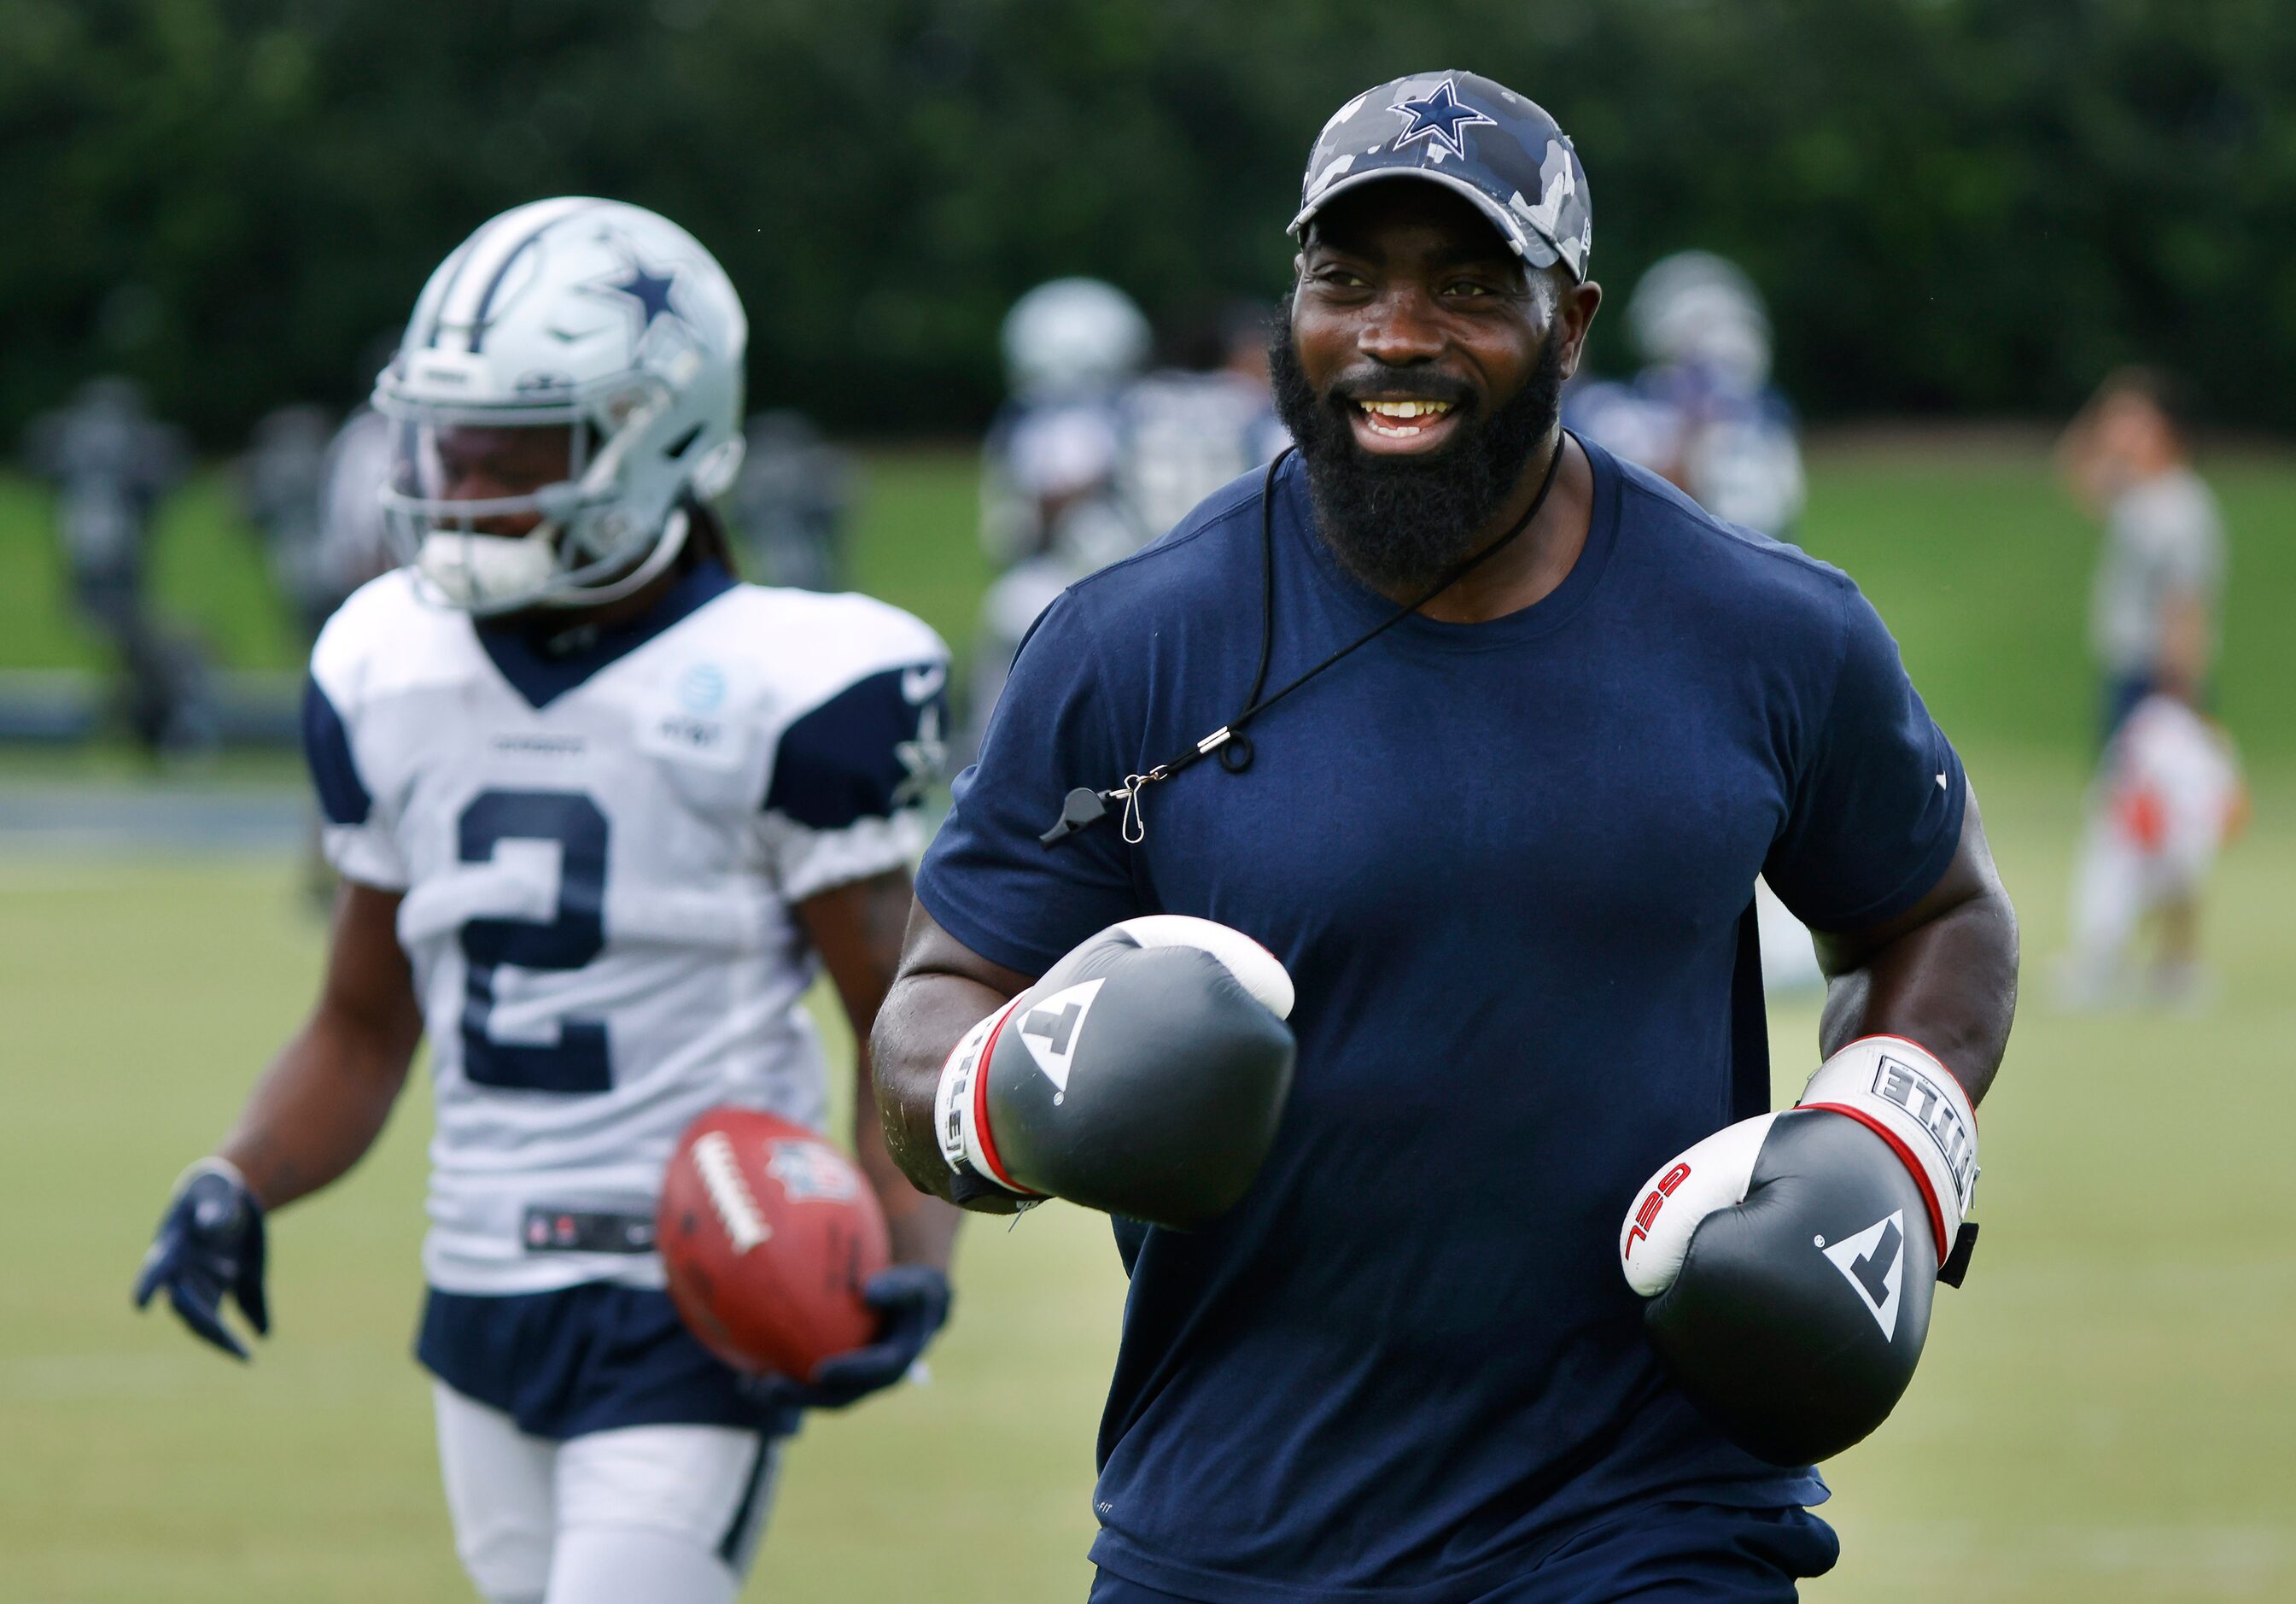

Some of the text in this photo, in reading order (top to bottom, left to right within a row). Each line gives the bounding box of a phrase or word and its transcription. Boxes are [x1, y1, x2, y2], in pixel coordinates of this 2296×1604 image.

[458, 790, 612, 1092] 2
[1022, 1002, 1083, 1055] T
[1625, 1162, 1692, 1262] GEL
[1849, 1218, 1903, 1310] T
